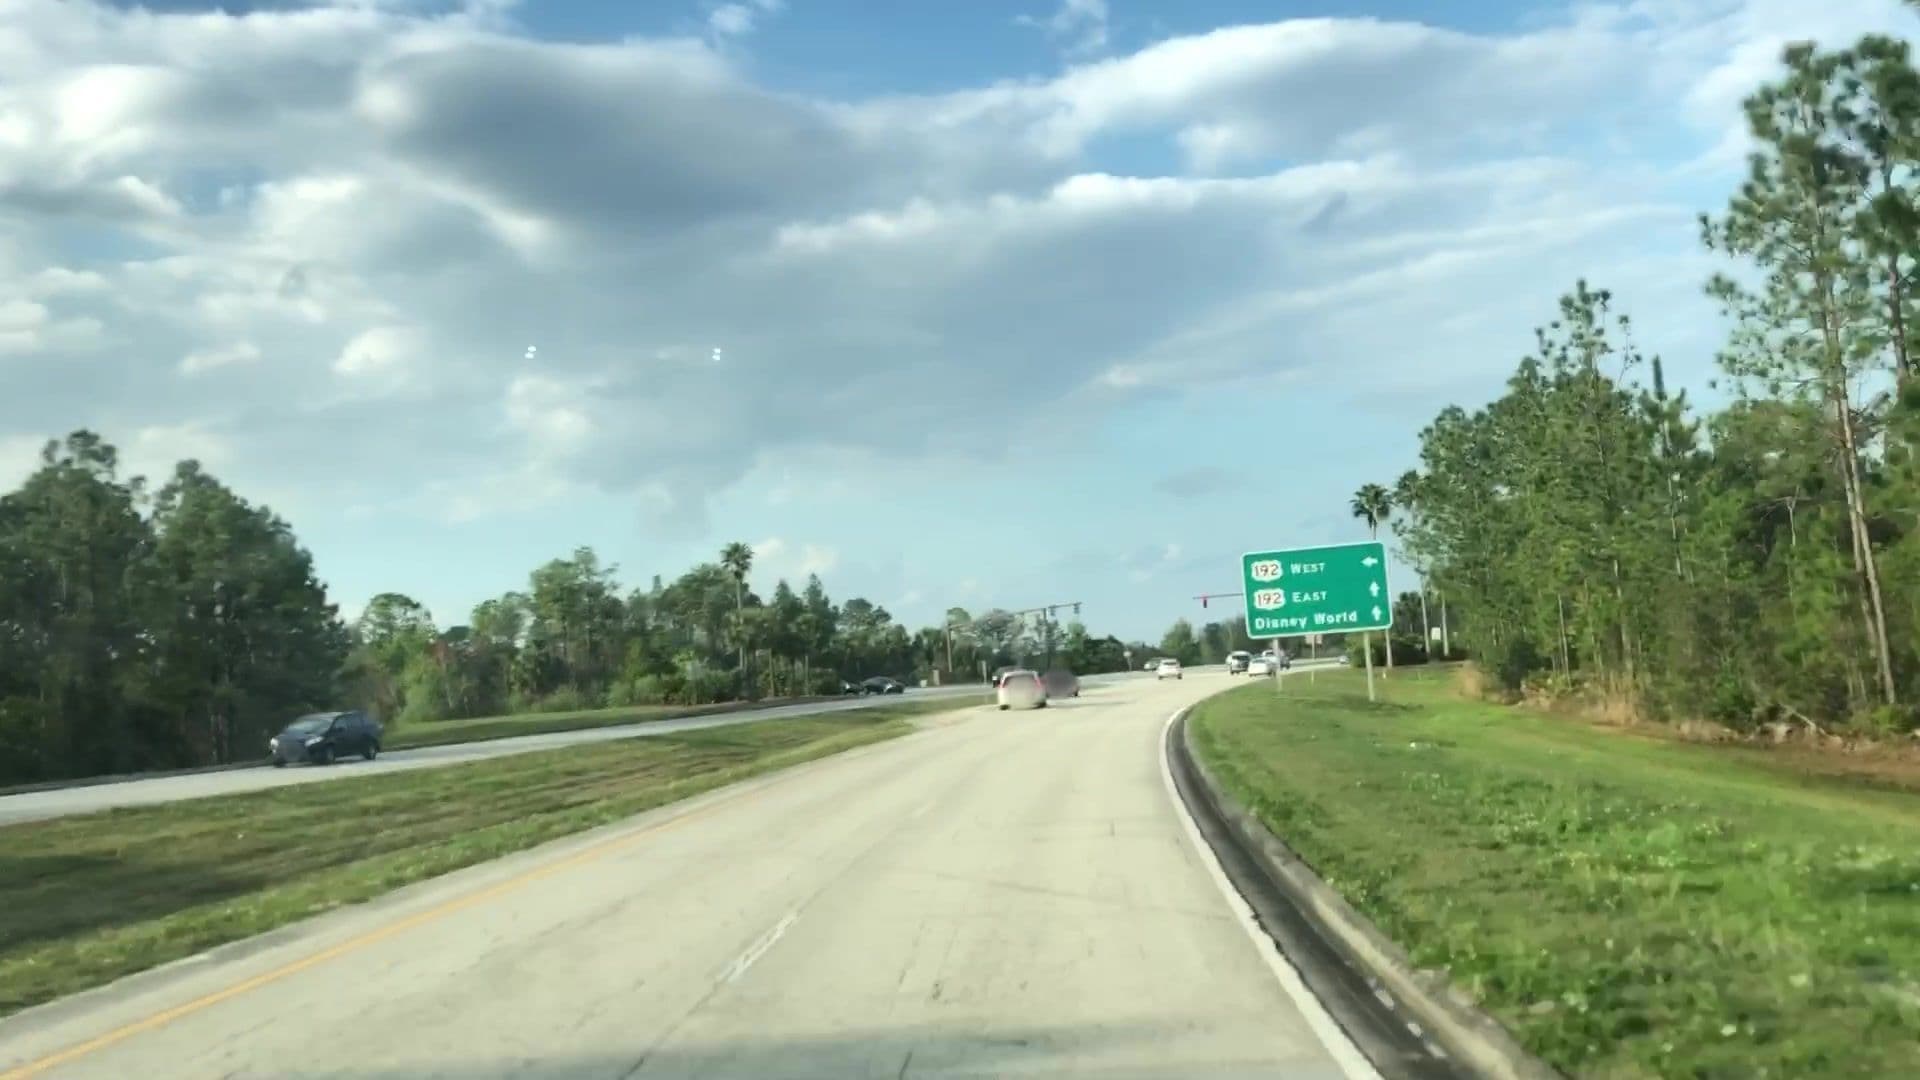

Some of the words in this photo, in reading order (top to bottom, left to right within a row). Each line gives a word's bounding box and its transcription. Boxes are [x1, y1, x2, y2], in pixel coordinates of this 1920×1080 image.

[1254, 563, 1279, 577] 192
[1290, 563, 1326, 575] WEST
[1257, 593, 1282, 606] 192
[1292, 591, 1328, 603] EAST
[1255, 616, 1308, 630] Disney
[1313, 611, 1358, 625] World
